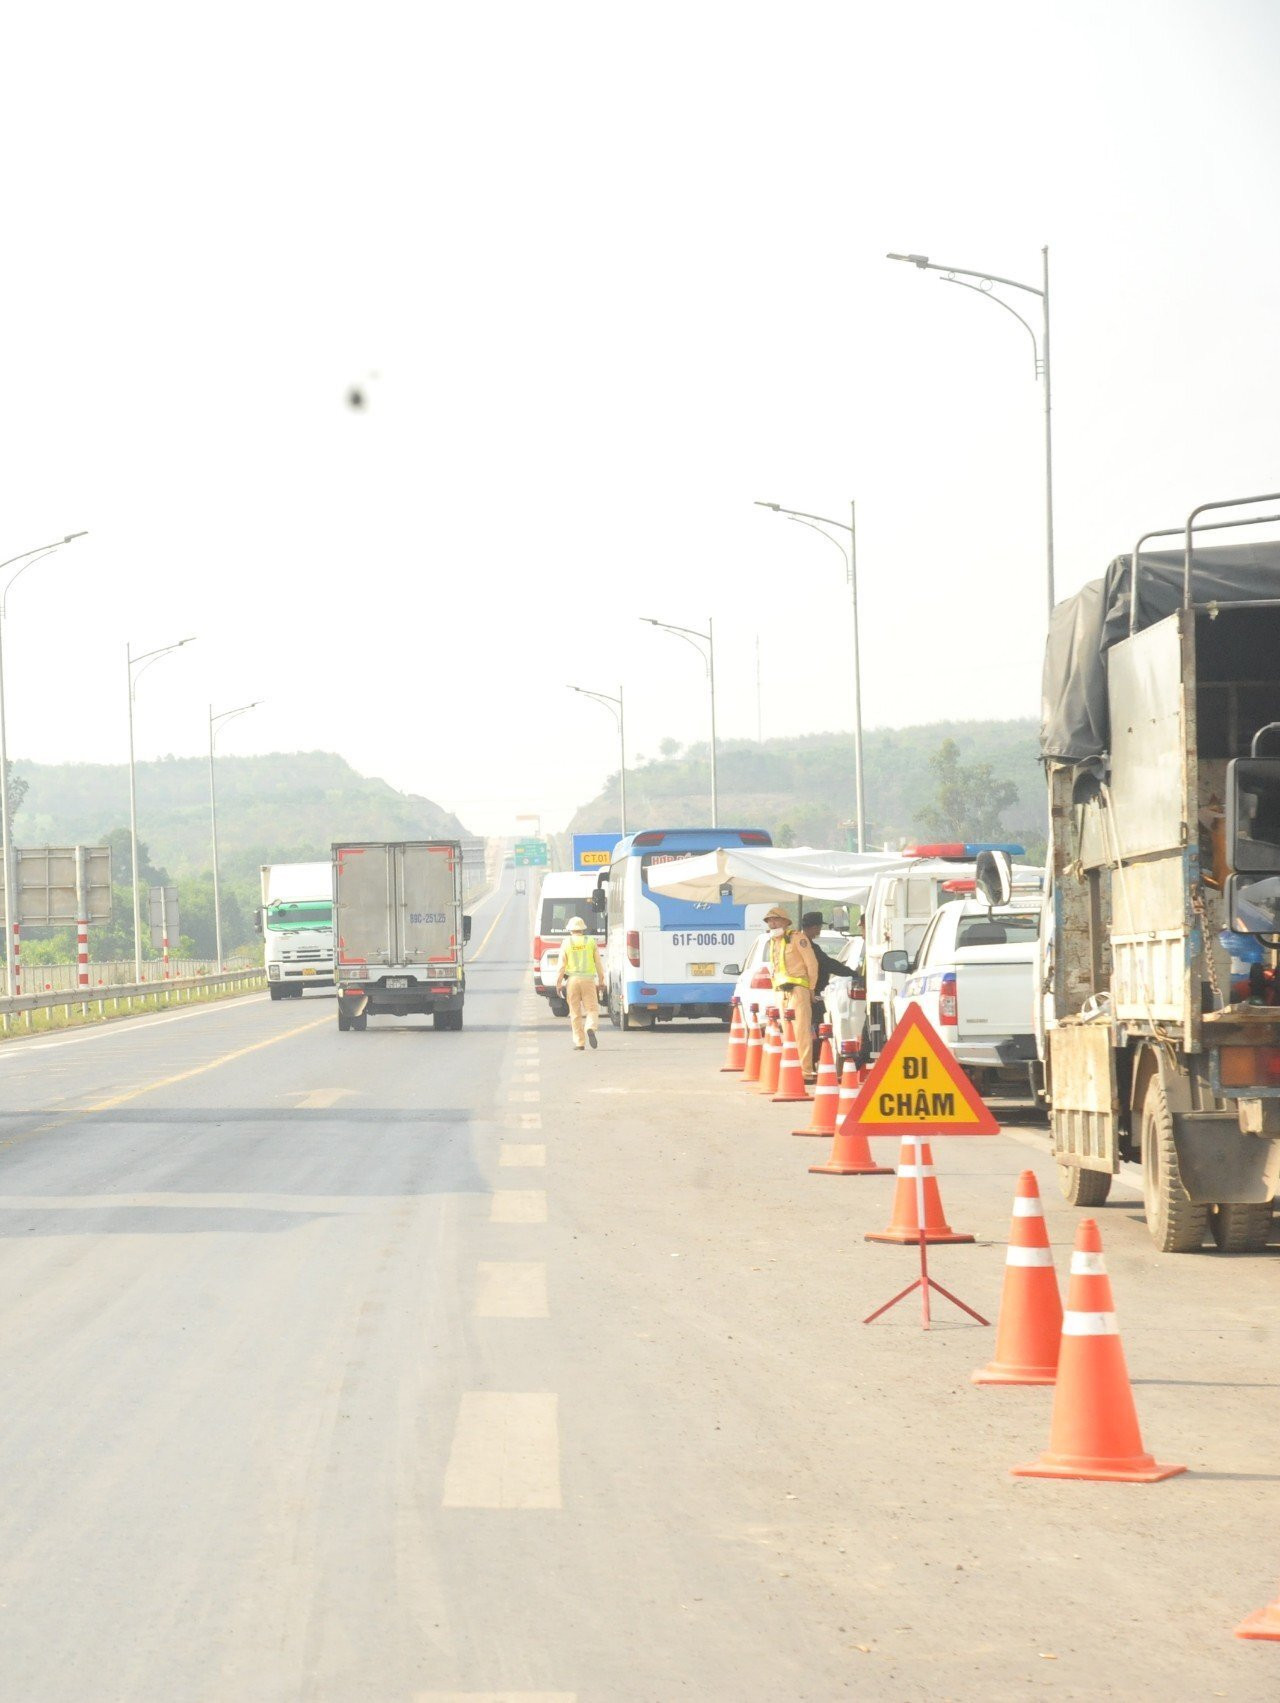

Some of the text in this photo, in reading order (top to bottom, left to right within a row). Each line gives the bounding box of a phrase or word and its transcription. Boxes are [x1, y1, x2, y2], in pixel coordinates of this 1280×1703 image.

[672, 932, 735, 946] 61F-006.00
[902, 1056, 928, 1079] ĐI
[879, 1088, 955, 1120] CHẬM
